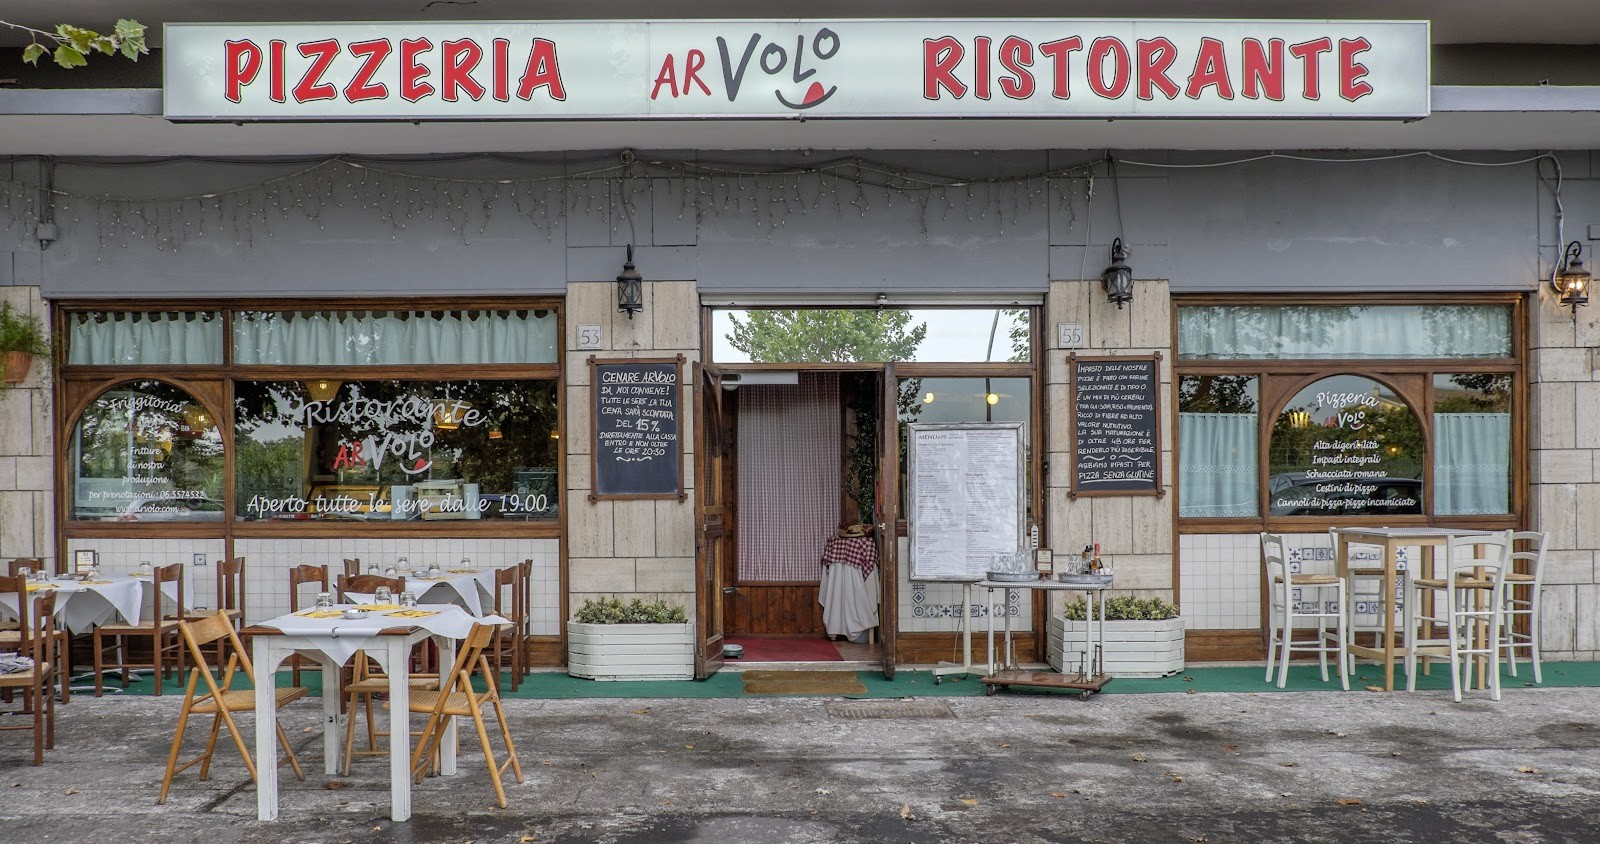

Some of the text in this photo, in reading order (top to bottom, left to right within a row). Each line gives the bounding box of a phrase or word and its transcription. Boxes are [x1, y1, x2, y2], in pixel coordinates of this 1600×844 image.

[224, 38, 566, 102] PIZZERIA
[923, 35, 1373, 102] RISTORANTE
[582, 330, 599, 344] 53
[1063, 329, 1080, 343] 55
[602, 372, 640, 383] CENARE
[601, 386, 613, 395] DA
[616, 386, 629, 394] NOI
[111, 395, 182, 412] Friggitoria
[660, 399, 672, 407] TUA
[1316, 392, 1380, 408] Pizzeria
[302, 398, 489, 428] Ristorante
[642, 409, 674, 420] SCONTATA
[616, 419, 632, 428] DEL
[1314, 440, 1332, 449] Alta
[130, 447, 161, 455] Fritture
[642, 448, 665, 456] 20:30
[138, 461, 164, 469] nostra
[1312, 454, 1381, 466] Impasti integrali
[1078, 471, 1099, 479] PIZZA
[1126, 470, 1154, 478] GLUTINE
[1306, 469, 1353, 478] Schiacciata
[122, 474, 169, 486] produzione
[1316, 483, 1378, 494] Cestini di pizza
[88, 491, 103, 500] per
[160, 491, 204, 499] 06.5574532
[246, 492, 548, 519] Aperto tutte le sere dalle 19.00
[1277, 498, 1310, 507] Cannoli
[1310, 498, 1321, 507] di
[1367, 498, 1417, 507] incamiciate
